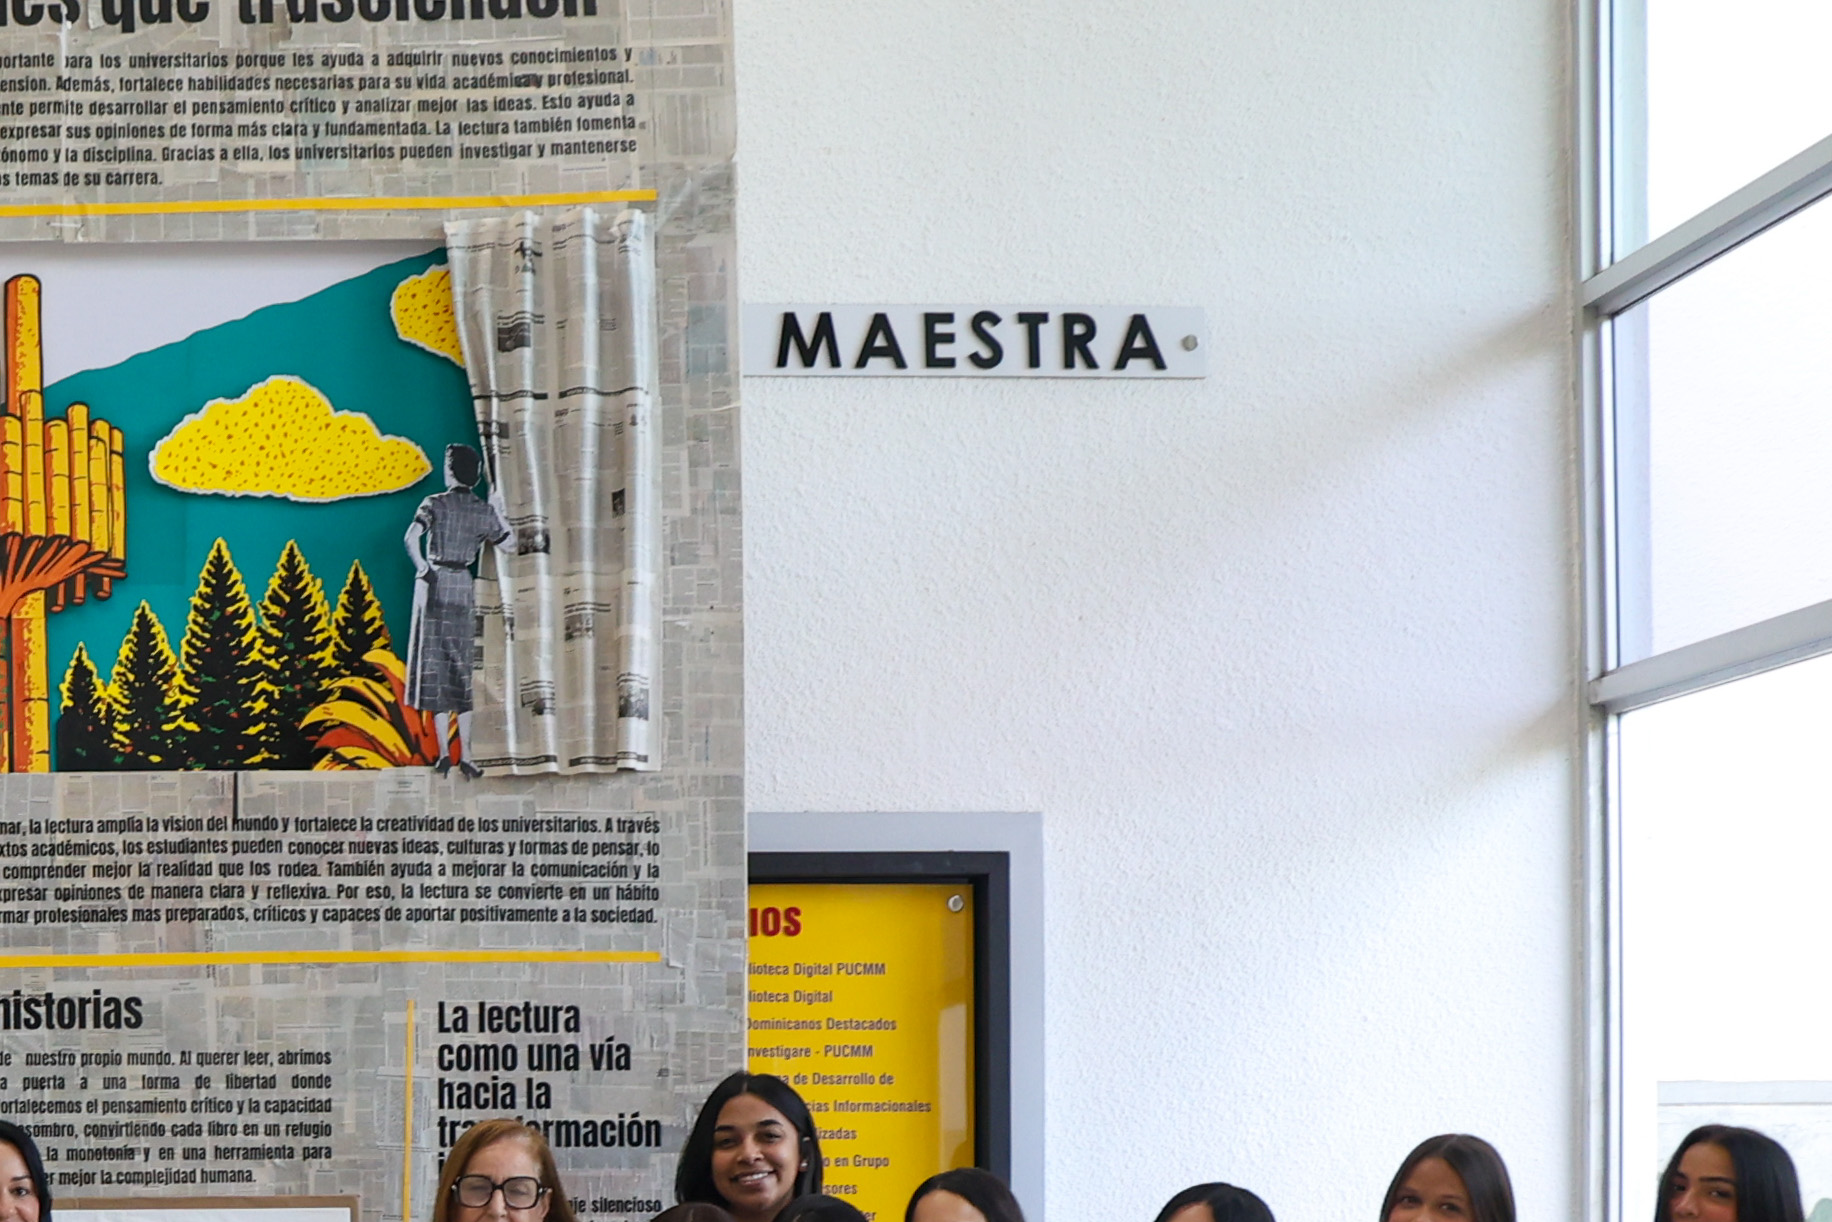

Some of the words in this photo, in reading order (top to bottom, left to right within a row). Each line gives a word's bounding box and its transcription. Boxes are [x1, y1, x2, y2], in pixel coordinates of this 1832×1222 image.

[16, 171, 59, 187] temas
[63, 170, 79, 186] de
[84, 171, 101, 186] su
[105, 172, 163, 186] carrera.
[776, 310, 1168, 370] MAESTRA
[34, 904, 128, 927] profesionales
[166, 905, 249, 925] preparados,
[253, 904, 306, 923] críticos
[310, 907, 318, 924] y
[322, 906, 380, 924] capaces
[385, 905, 402, 922] de
[405, 906, 455, 923] aportar
[460, 905, 558, 924] positivamente
[562, 909, 569, 922] a
[574, 905, 586, 922] la
[591, 906, 658, 923] sociedad.
[794, 962, 833, 978] Digital
[837, 962, 885, 975] PUCMM
[794, 989, 833, 1005] Digital
[438, 1001, 468, 1033] La
[478, 1001, 580, 1033] lectura
[826, 1017, 897, 1030] Destacados
[438, 1043, 518, 1072] como
[527, 1043, 580, 1072] una
[589, 1035, 631, 1071] vía
[824, 1045, 873, 1057] PUCMM
[22, 1074, 65, 1092] puerta
[80, 1077, 88, 1090] a
[102, 1077, 126, 1090] una
[142, 1074, 180, 1090] forma
[194, 1074, 211, 1090] de
[226, 1073, 276, 1089] libertad
[291, 1074, 332, 1090] donde
[794, 1073, 808, 1085] de
[812, 1072, 875, 1085] Desarrollo
[879, 1073, 894, 1085] de
[438, 1075, 516, 1110] hacia
[525, 1077, 551, 1110] la
[833, 1100, 931, 1112] Informacionales
[835, 1156, 848, 1166] en
[853, 1155, 889, 1169] Grupo
[591, 1196, 662, 1213] silencioso
